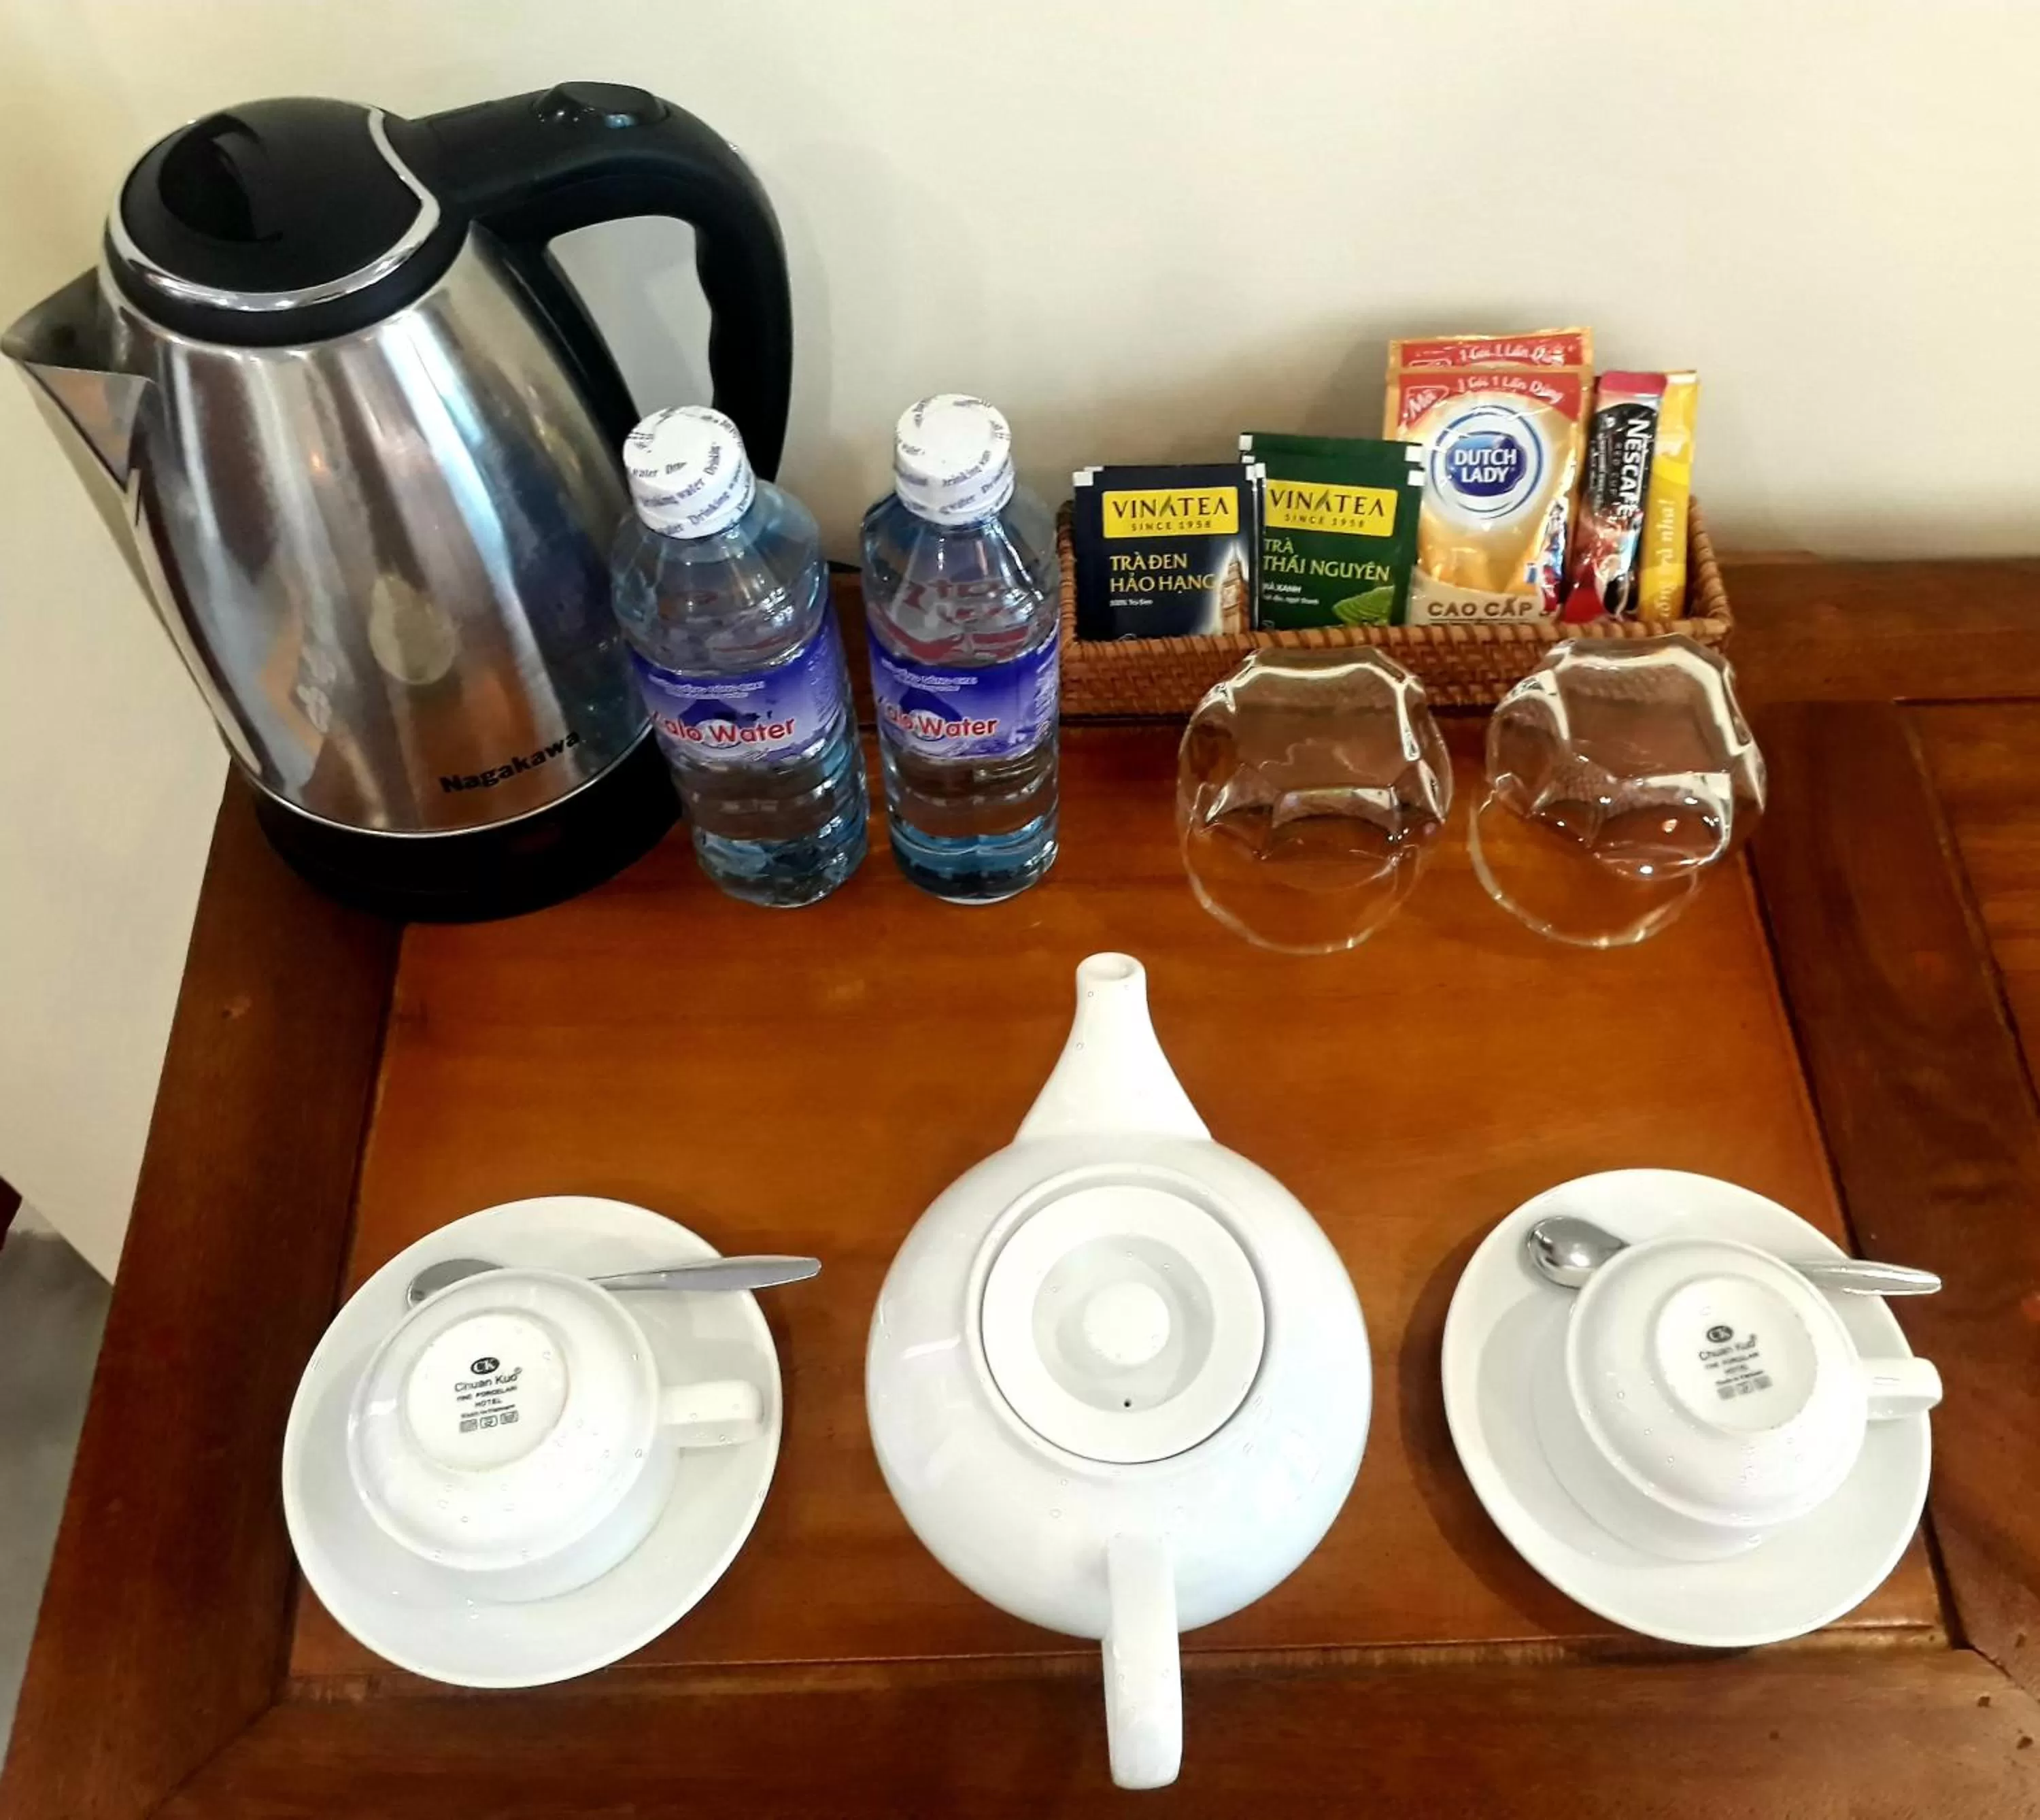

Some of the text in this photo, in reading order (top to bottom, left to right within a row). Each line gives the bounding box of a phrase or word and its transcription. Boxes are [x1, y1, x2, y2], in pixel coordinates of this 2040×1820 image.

[1455, 448, 1517, 465] DUTCH
[1461, 467, 1509, 483] LADY
[1132, 520, 1212, 531] SINCE 1958
[1285, 514, 1325, 524] SINCE
[1263, 537, 1294, 554] TRÀ
[1110, 552, 1189, 571] TRÀ ĐEN
[1263, 554, 1391, 582] THÁI NGUYÊN
[1110, 573, 1155, 593] HẢO
[1427, 596, 1533, 617] CAO CẤP
[708, 718, 796, 743] Water
[917, 717, 998, 738] Water
[439, 731, 581, 793] Nagakawa
